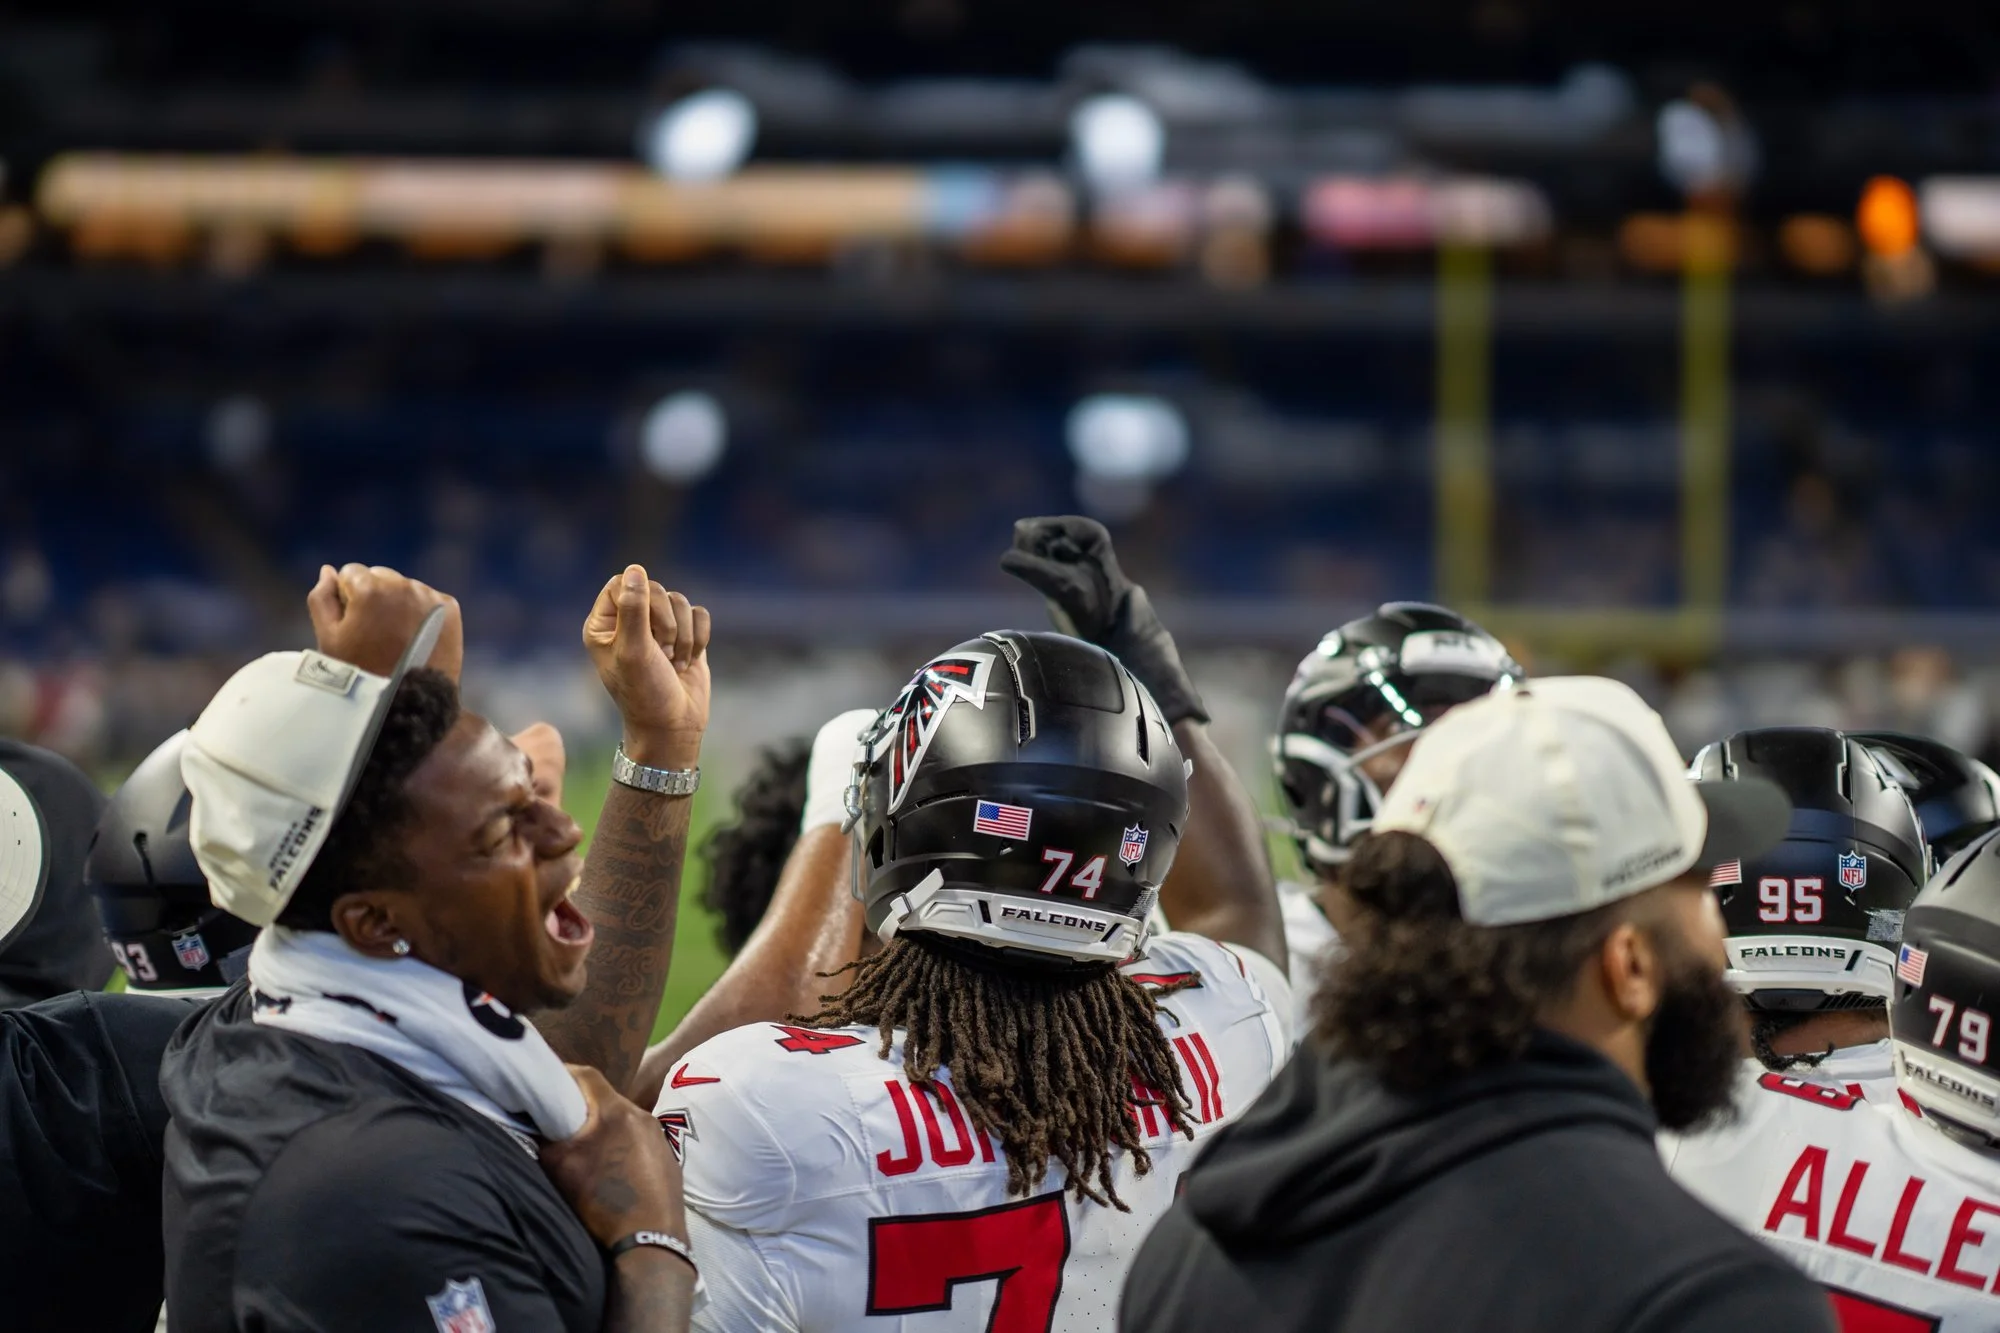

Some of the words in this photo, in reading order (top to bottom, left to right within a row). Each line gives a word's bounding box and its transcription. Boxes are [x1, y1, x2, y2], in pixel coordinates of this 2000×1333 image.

[269, 805, 324, 891] FALCONS
[1122, 842, 1142, 861] NFL
[1039, 847, 1108, 900] 74
[1842, 868, 1863, 884] NFL
[1001, 906, 1107, 932] FALCONS
[1758, 876, 1823, 924] 95
[1741, 946, 1846, 959] FALCONS
[1928, 994, 1991, 1064] 79
[1905, 1062, 1995, 1106] FALCONS
[1764, 1144, 2000, 1296] ALLE
[866, 1190, 1071, 1333] 7
